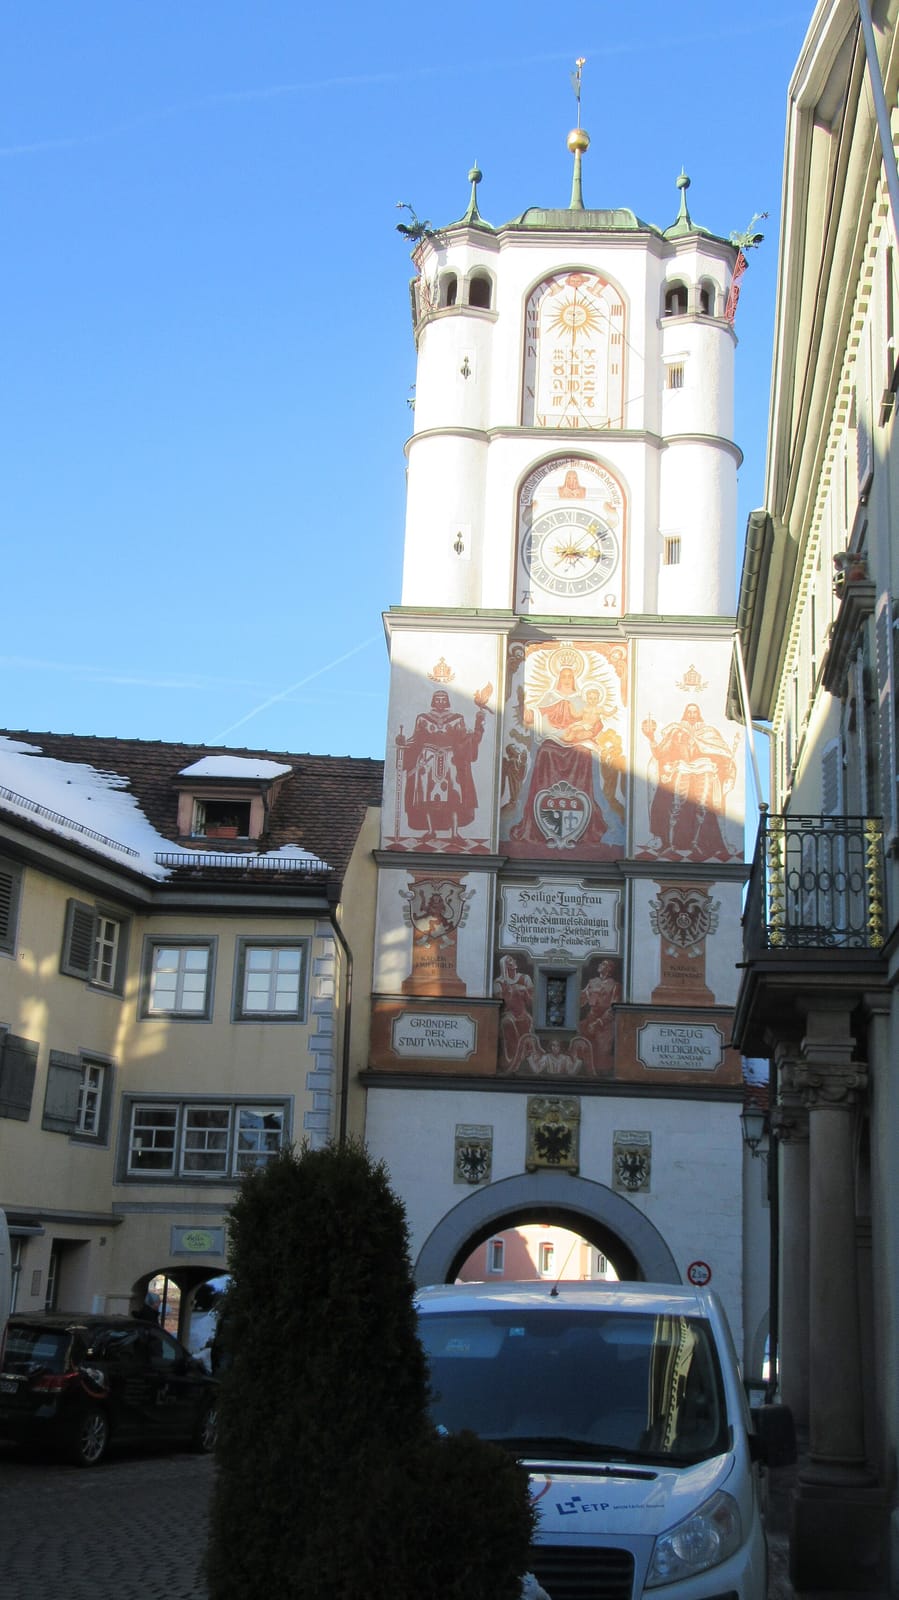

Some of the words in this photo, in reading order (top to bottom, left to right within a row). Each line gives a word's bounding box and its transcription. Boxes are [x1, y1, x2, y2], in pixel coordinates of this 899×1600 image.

[519, 890, 556, 907] Heilige
[556, 891, 602, 907] Jungfrau
[533, 907, 588, 916] MARIA
[508, 922, 555, 935] Schirmerin
[410, 1018, 458, 1029] GRÜNDER
[425, 1030, 445, 1038] DER
[660, 1028, 703, 1039] EINZUG
[398, 1037, 426, 1048] STADT
[427, 1039, 469, 1049] WANGEN
[671, 1037, 690, 1045] UND
[651, 1044, 712, 1055] HULDIGUNG
[581, 1502, 610, 1513] ETP
